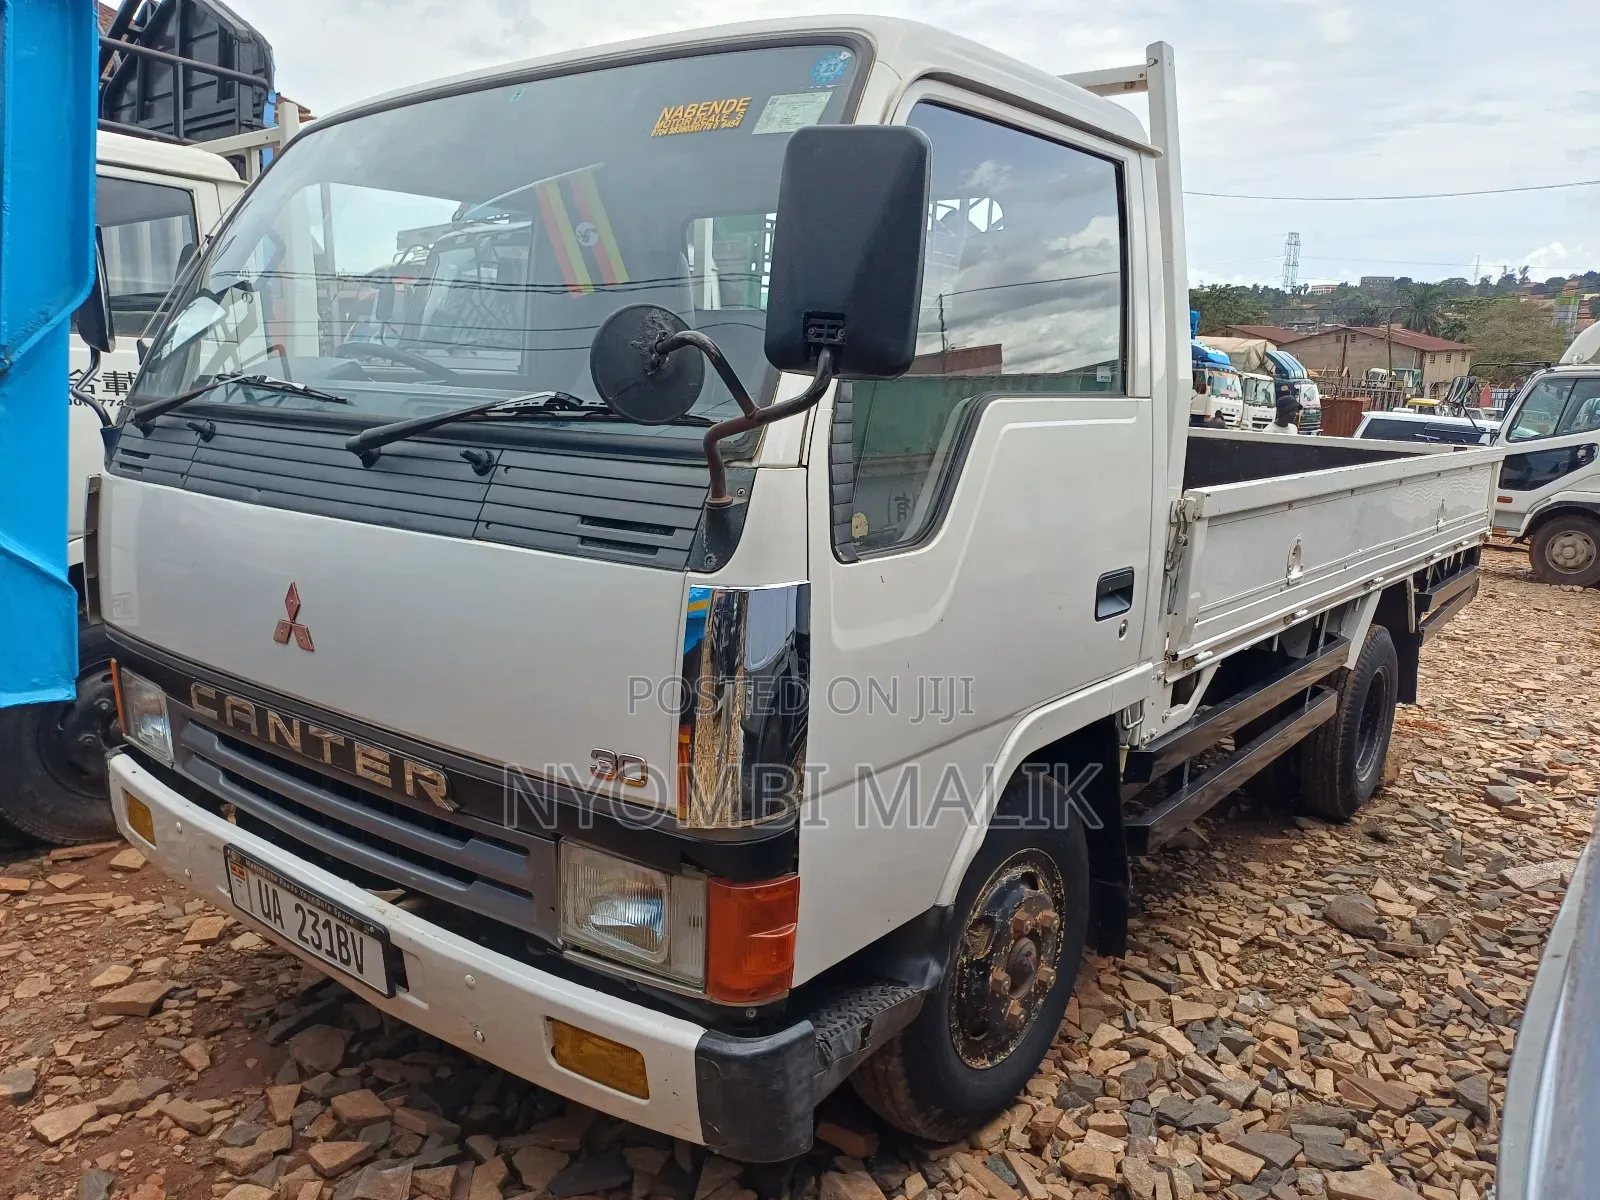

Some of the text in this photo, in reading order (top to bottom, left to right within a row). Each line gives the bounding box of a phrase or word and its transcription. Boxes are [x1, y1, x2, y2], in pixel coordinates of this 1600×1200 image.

[655, 111, 745, 129] MOTOR DEALES
[658, 96, 752, 121] NABENDE
[190, 681, 460, 813] CANTER
[590, 747, 649, 787] 30
[257, 878, 364, 975] UA 231BV
